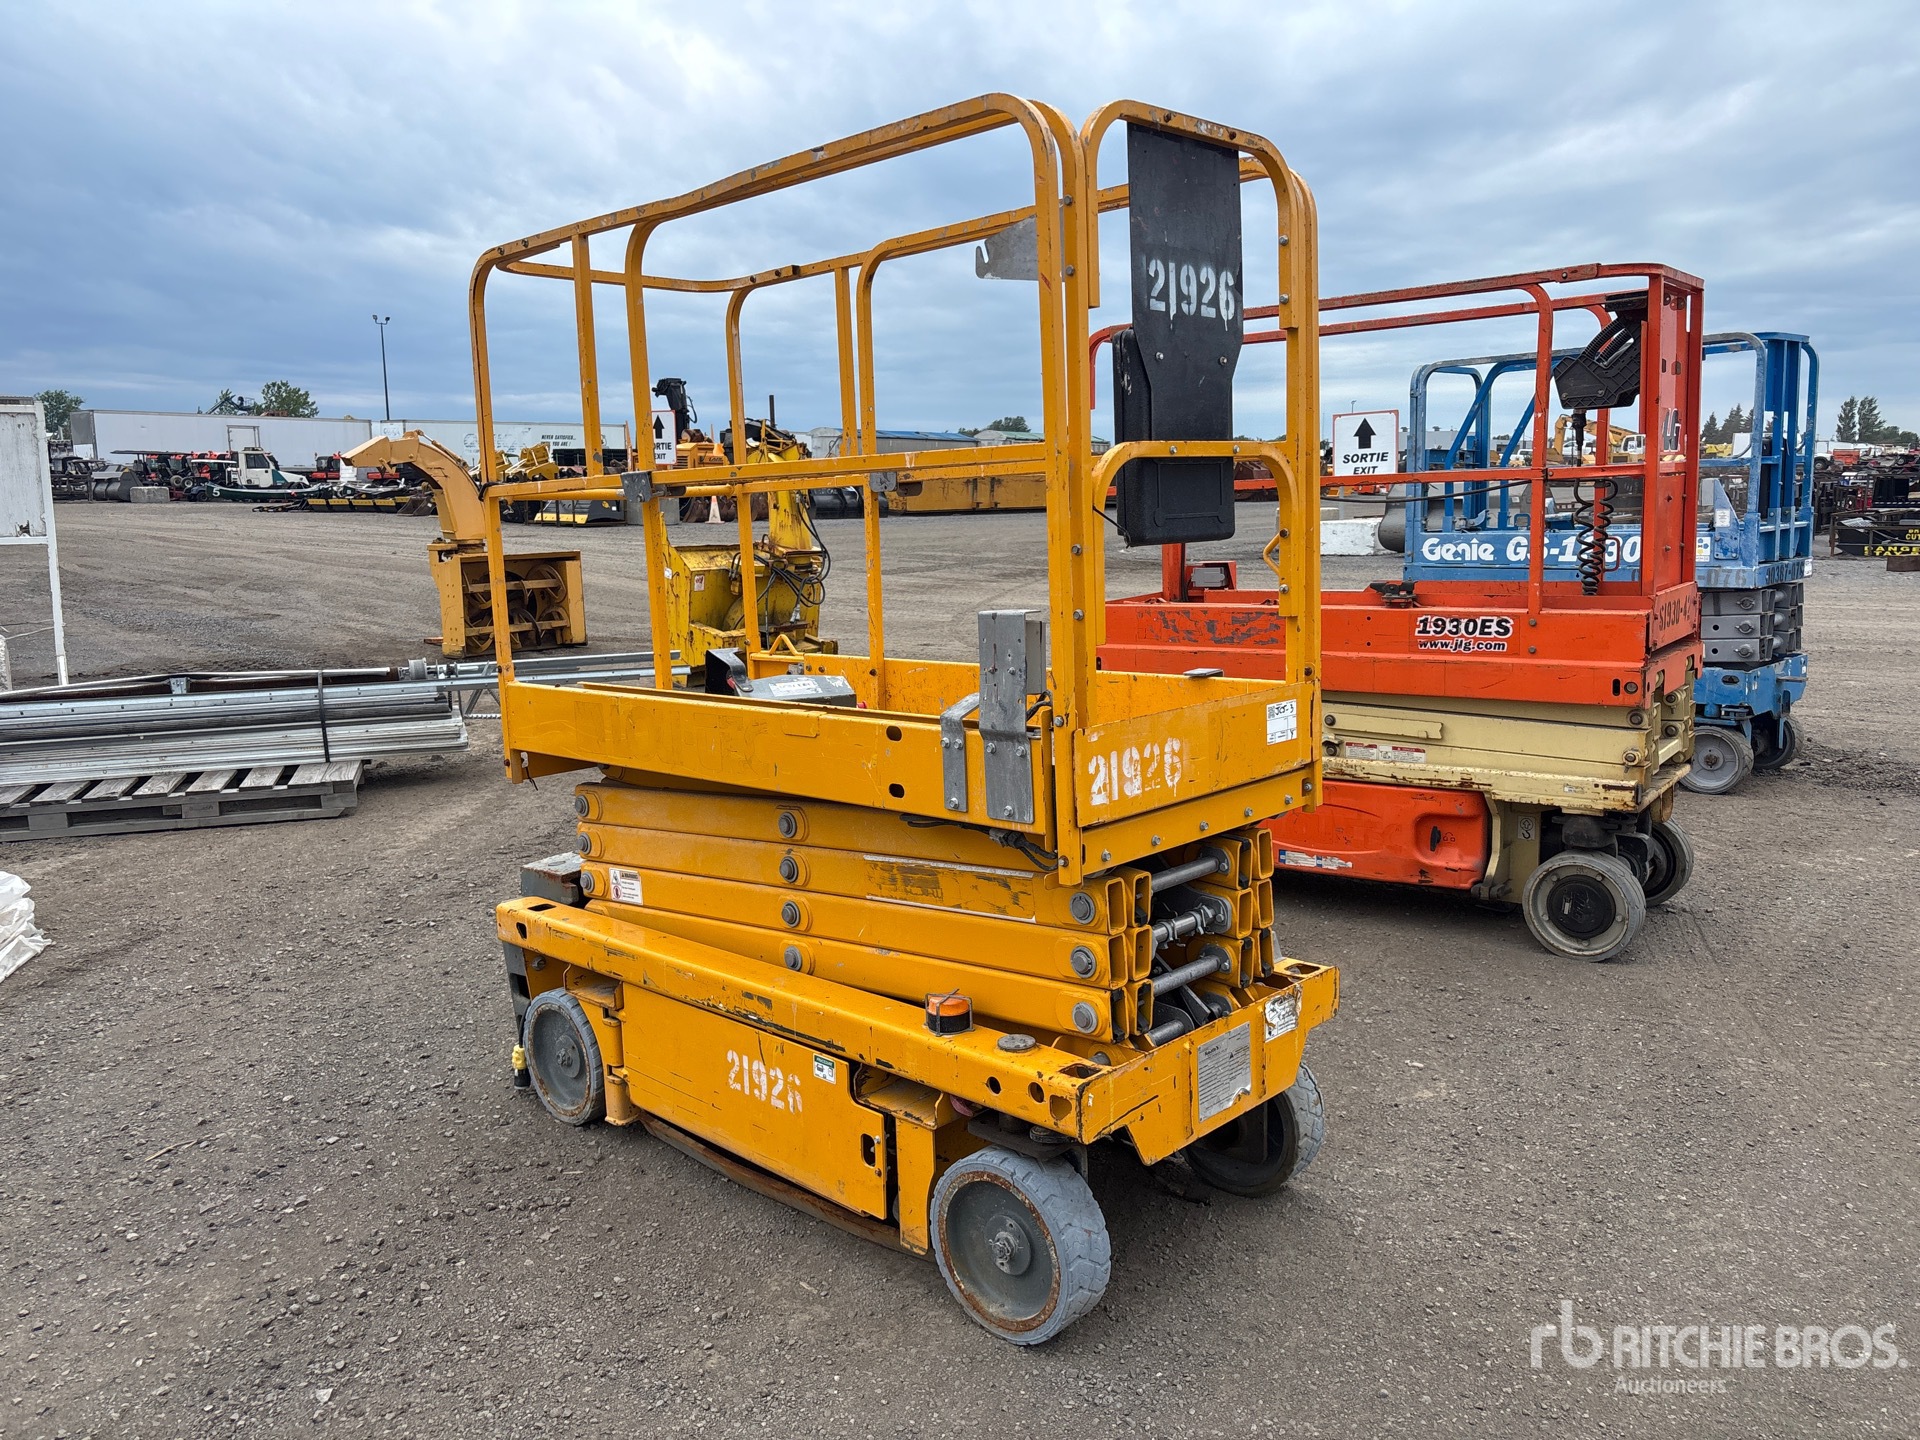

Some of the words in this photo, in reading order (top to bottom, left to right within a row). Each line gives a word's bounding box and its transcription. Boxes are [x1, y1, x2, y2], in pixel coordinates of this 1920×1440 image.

[1148, 259, 1235, 322] 21926
[653, 442, 672, 450] RTIE
[1342, 451, 1389, 464] SORTIE
[1353, 465, 1378, 475] EXIT
[1421, 537, 1495, 561] Genie
[1416, 615, 1512, 637] 1930ES
[1418, 639, 1506, 652] www.jlg.com
[1087, 737, 1183, 806] 21926
[727, 1050, 803, 1115] 21926
